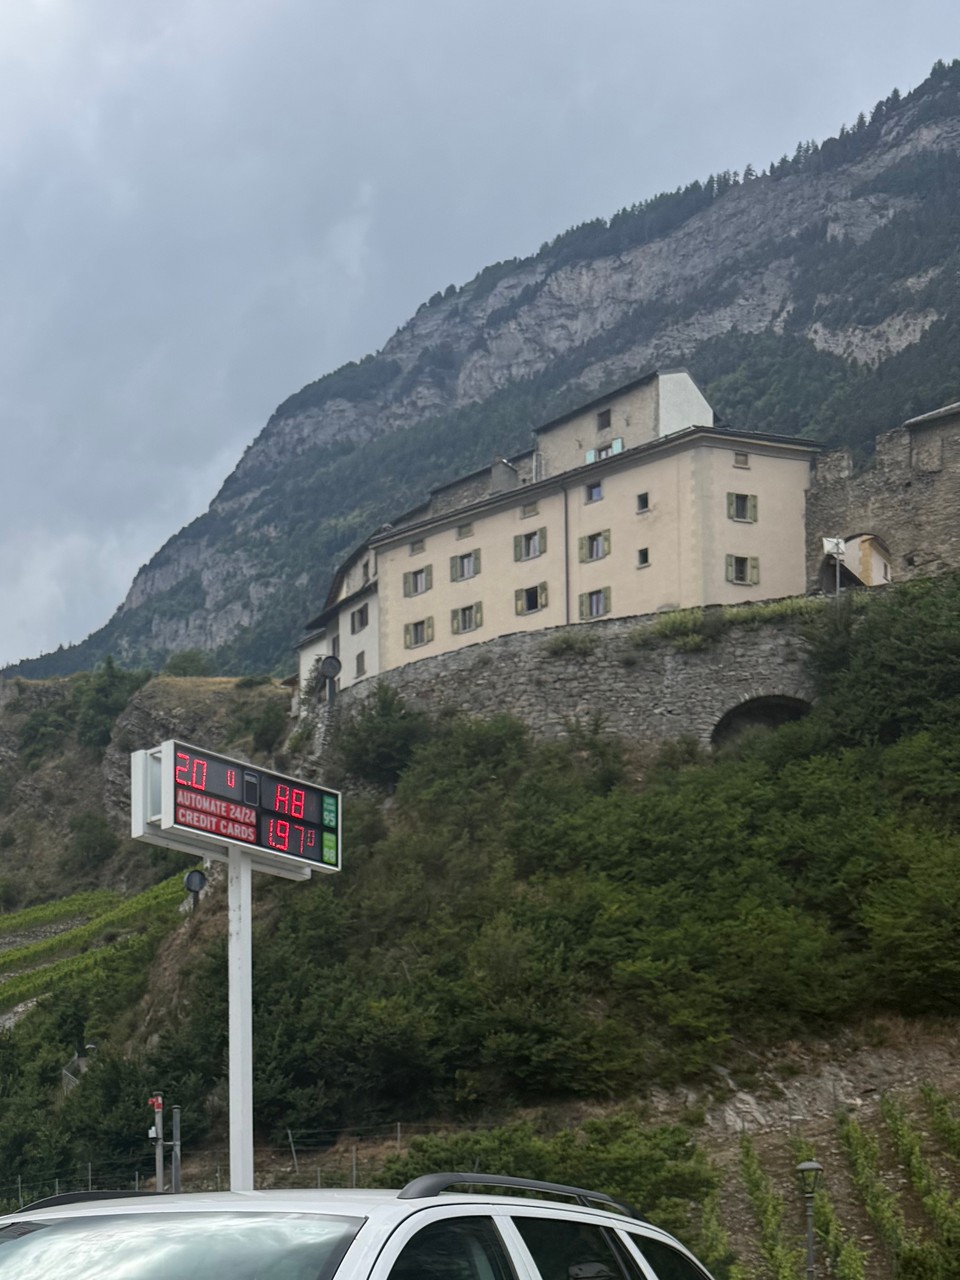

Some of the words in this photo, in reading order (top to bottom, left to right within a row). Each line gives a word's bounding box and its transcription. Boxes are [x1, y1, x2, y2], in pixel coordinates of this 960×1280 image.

[176, 790, 227, 816] AUTOMATE
[229, 804, 257, 826] 24/24
[178, 808, 217, 832] CREDIT
[219, 820, 256, 841] CARDS
[323, 811, 337, 829] 95
